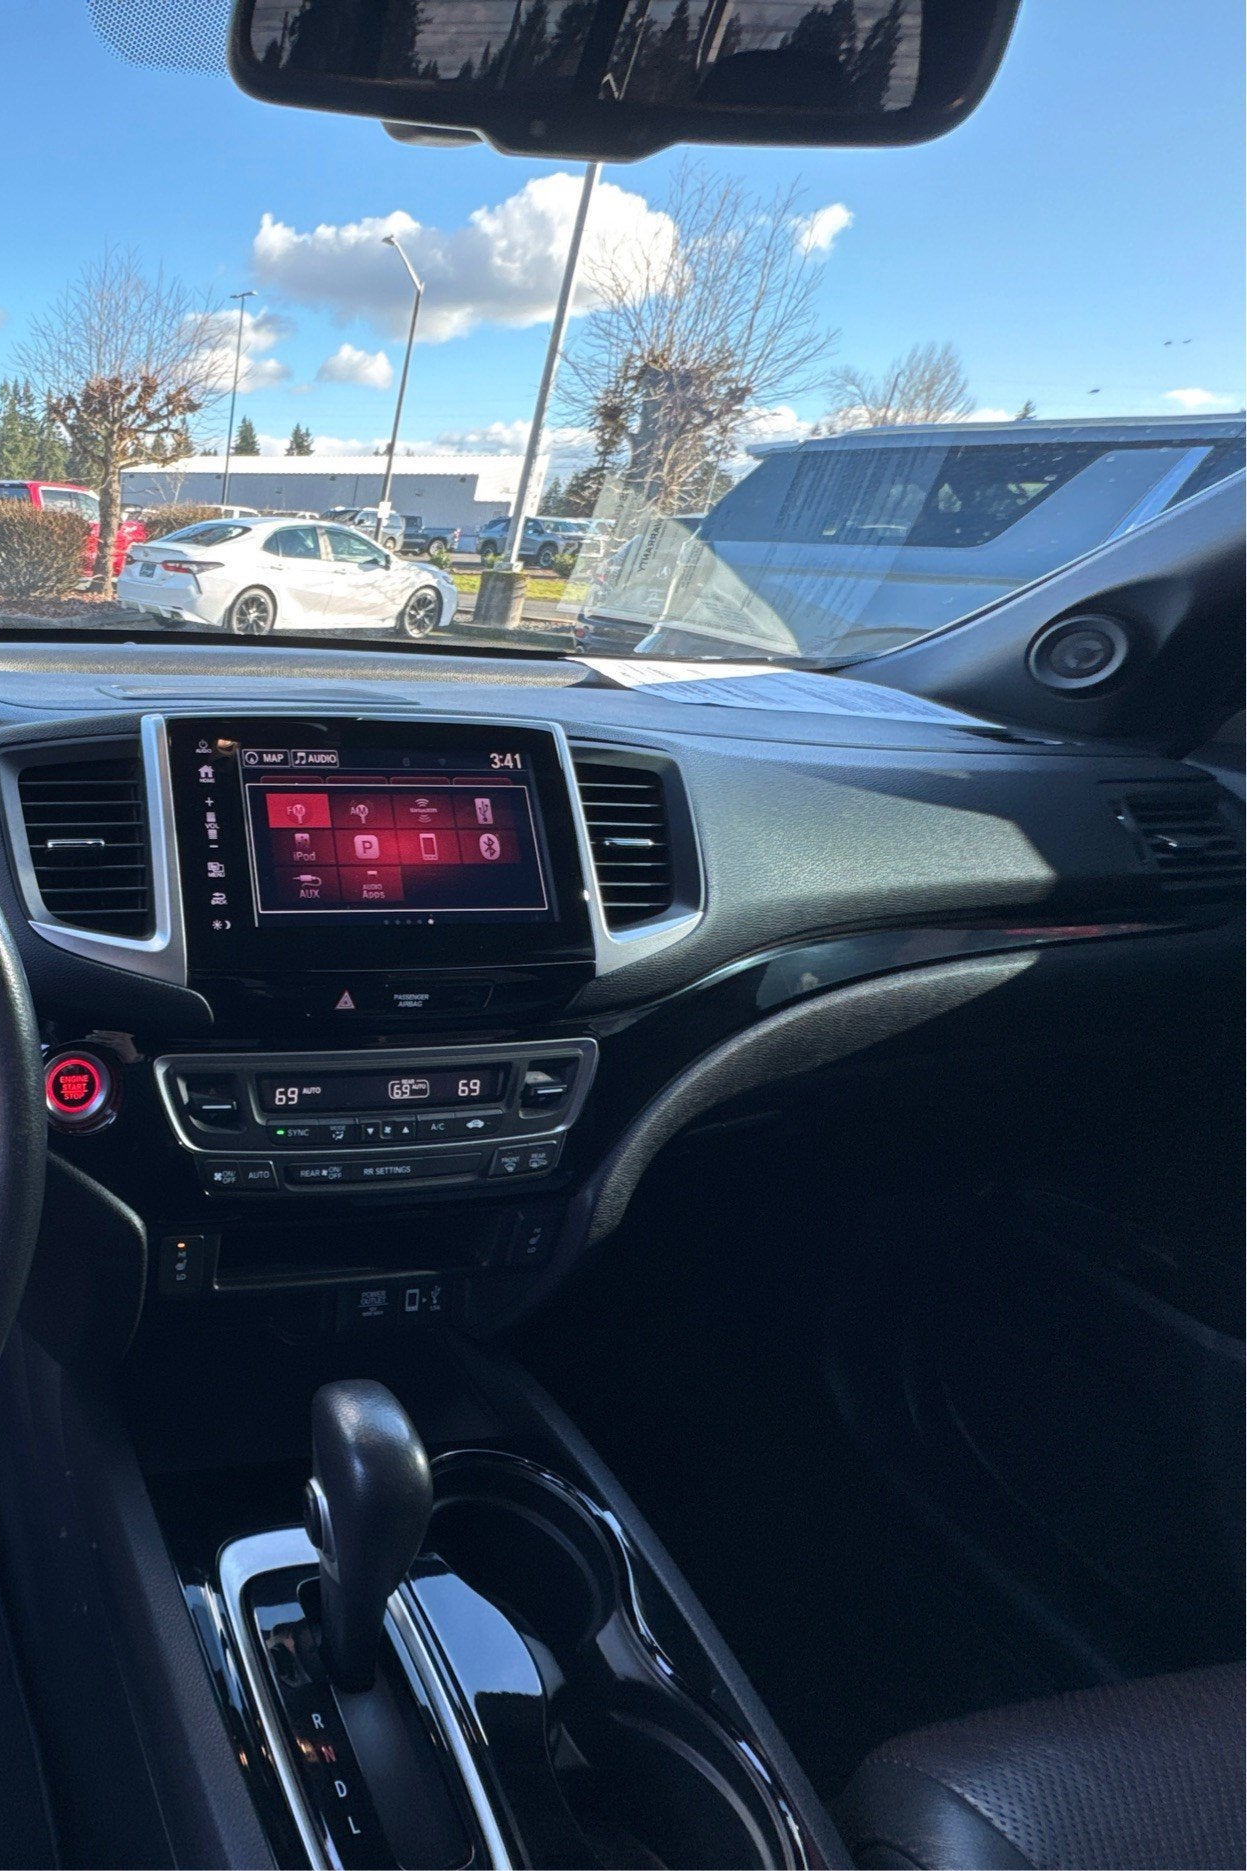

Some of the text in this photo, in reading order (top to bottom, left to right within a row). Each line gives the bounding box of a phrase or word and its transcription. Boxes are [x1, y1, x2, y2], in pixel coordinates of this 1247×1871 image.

[262, 753, 284, 763] MAP
[308, 753, 338, 764] AUDIO
[490, 752, 522, 769] 3:41
[293, 851, 316, 862] iPod
[299, 889, 320, 899] AUX
[362, 890, 385, 900] Apps
[60, 1074, 89, 1083] ENGINE
[62, 1083, 88, 1091] START
[393, 1084, 411, 1098] 69
[458, 1079, 481, 1096] 69
[275, 1086, 321, 1105] 69 AUTO
[430, 1122, 445, 1131] A/C
[287, 1128, 310, 1137] SYNC
[248, 1171, 270, 1179] AUTO
[300, 1169, 320, 1177] REAR
[376, 1165, 411, 1175] SETTINGS
[311, 1713, 324, 1729] R
[321, 1745, 336, 1763] N
[334, 1780, 347, 1798] D
[347, 1816, 361, 1835] L
